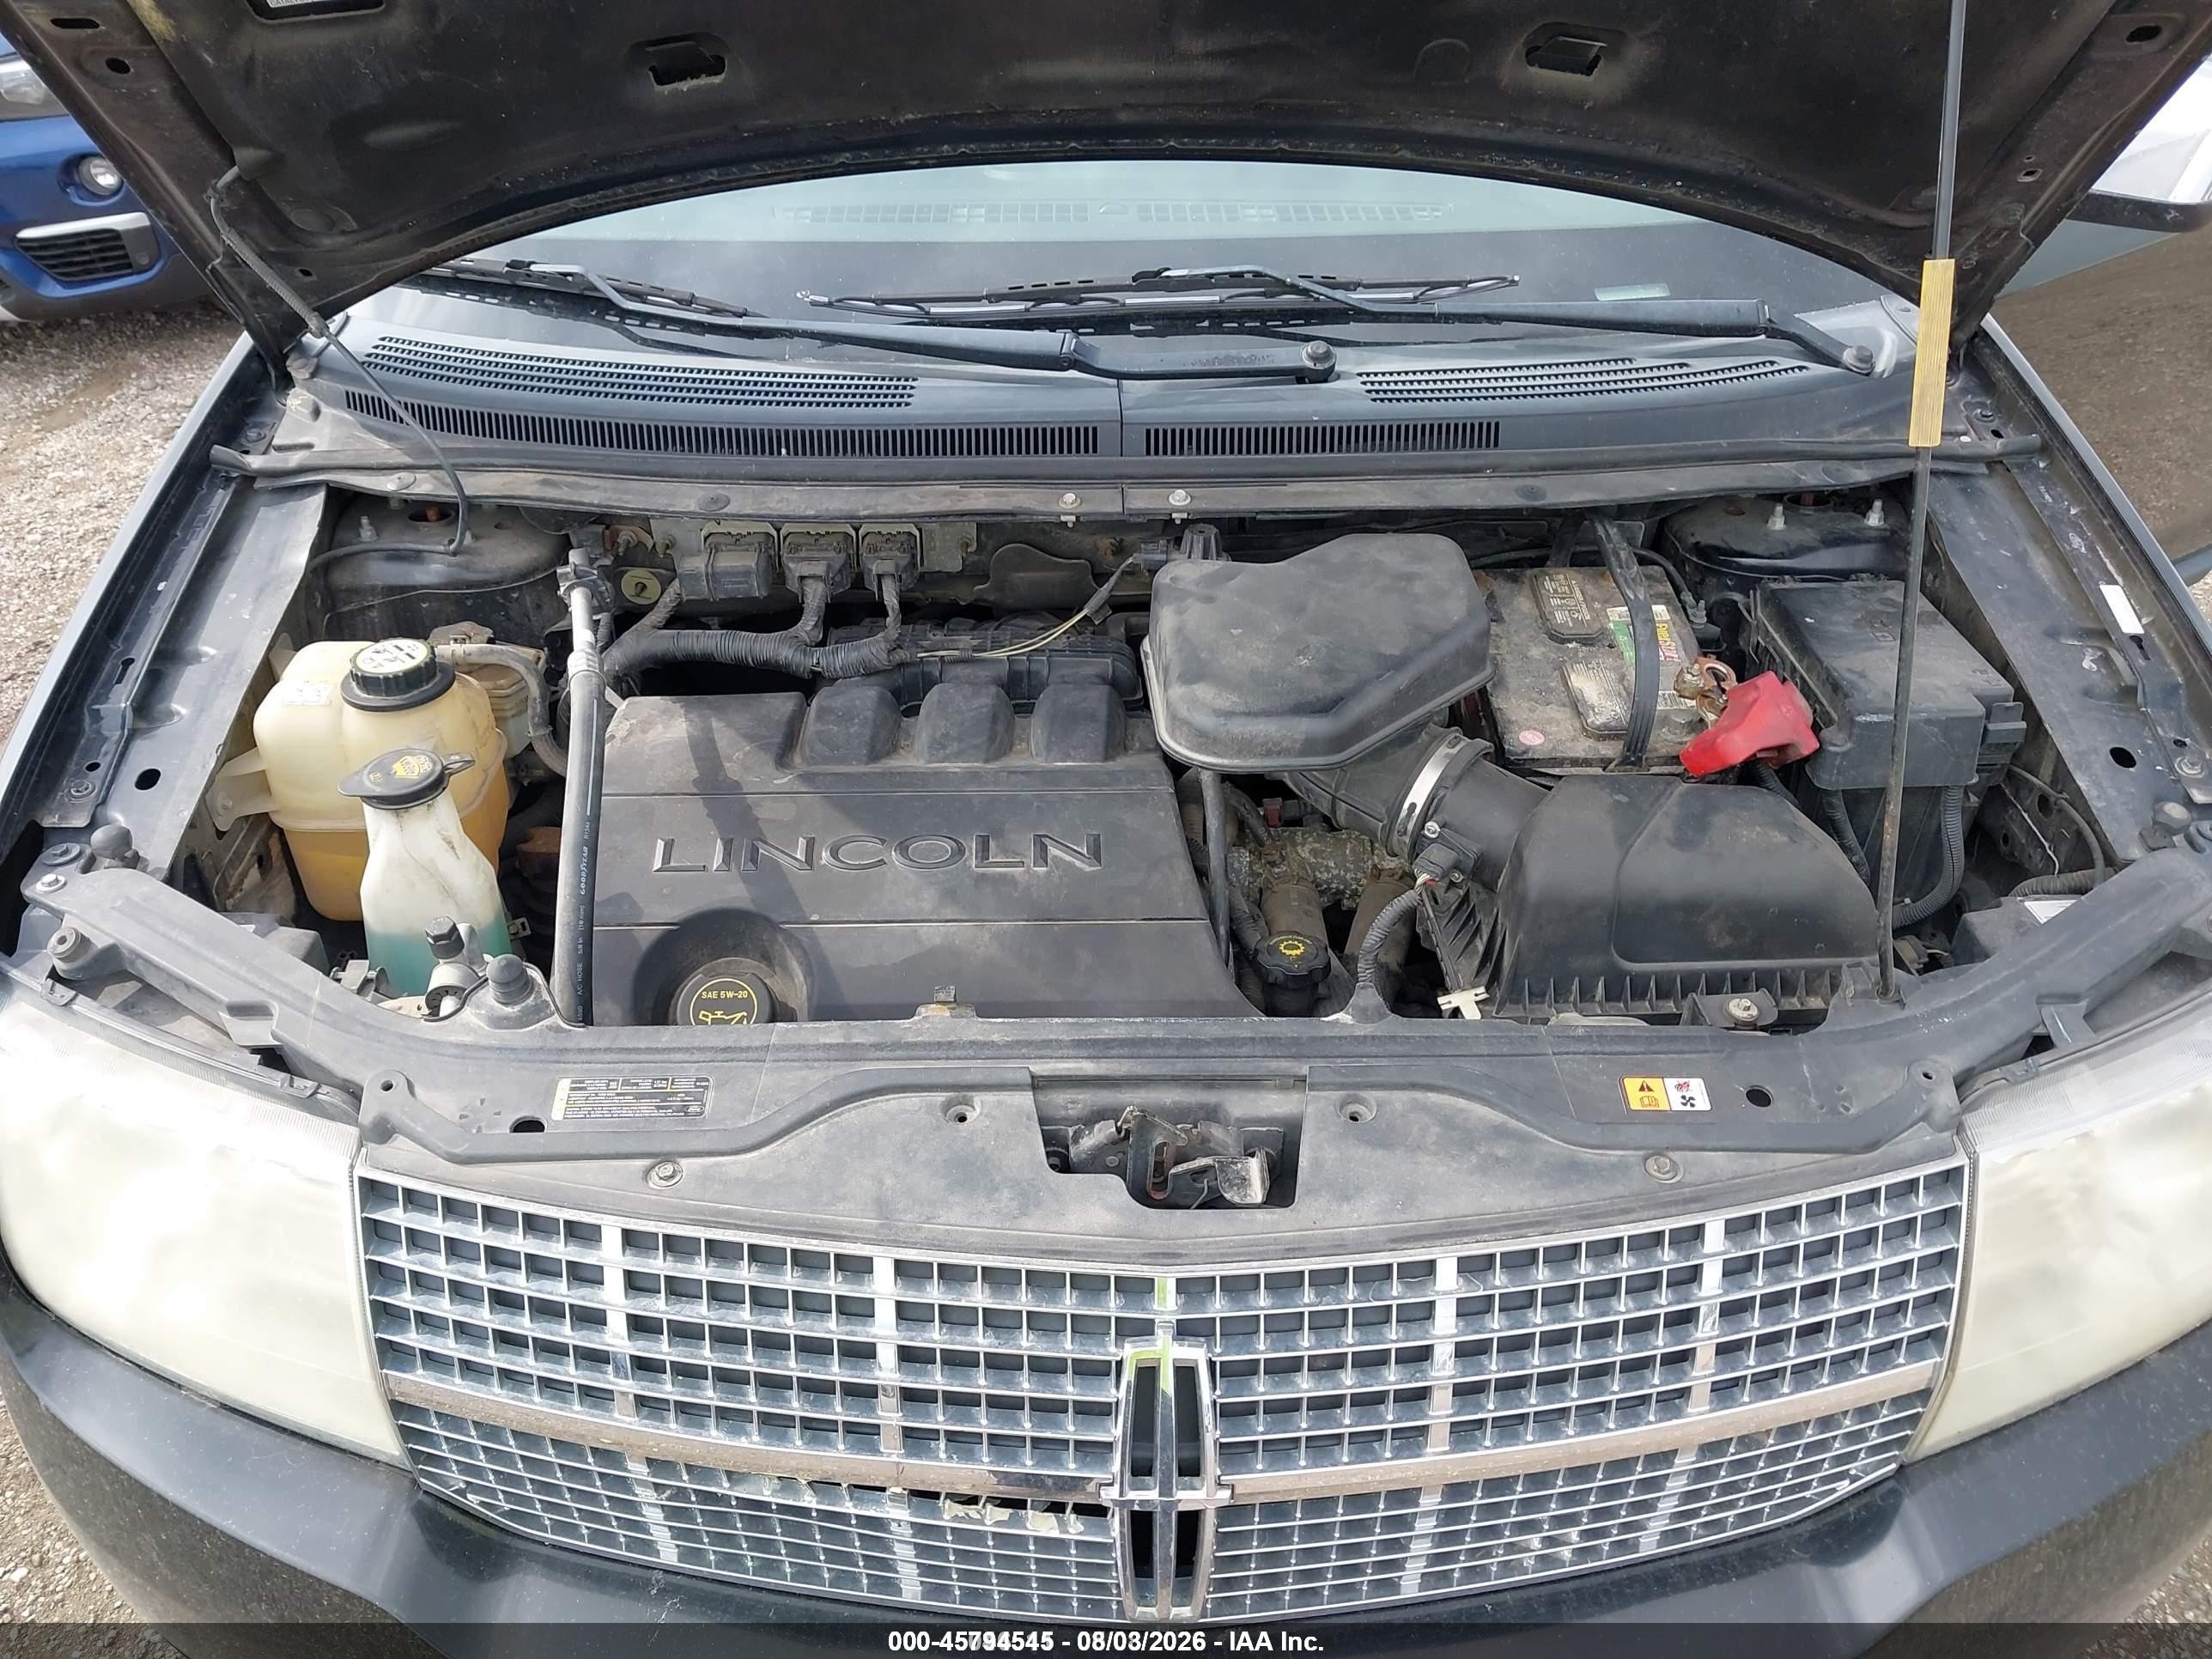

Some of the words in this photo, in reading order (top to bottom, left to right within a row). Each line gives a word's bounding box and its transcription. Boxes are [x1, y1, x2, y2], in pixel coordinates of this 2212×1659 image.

[580, 846, 589, 895] GOODYEAR
[653, 834, 1103, 872] LINCOLN
[701, 990, 718, 1000] SAE
[720, 990, 748, 1000] 5W-20
